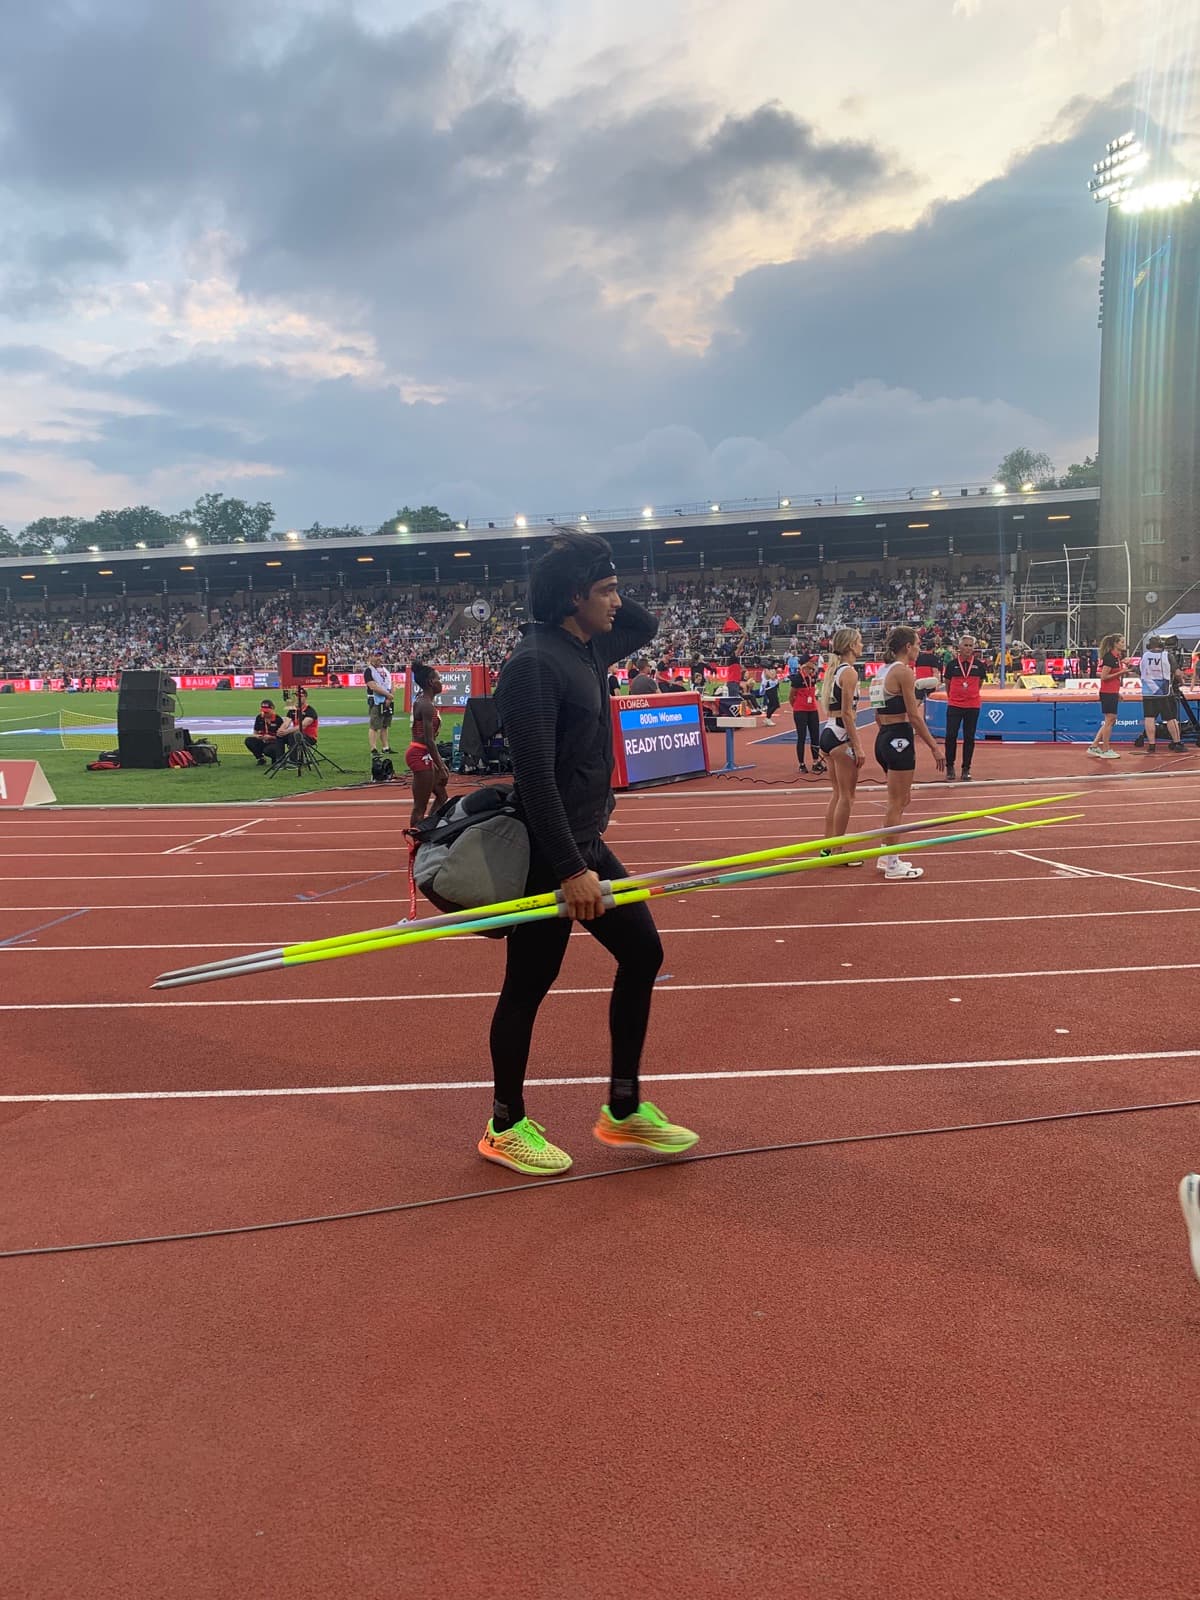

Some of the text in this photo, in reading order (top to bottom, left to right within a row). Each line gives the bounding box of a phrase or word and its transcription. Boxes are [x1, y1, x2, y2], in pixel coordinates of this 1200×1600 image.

[313, 655, 326, 676] 2
[1147, 657, 1161, 666] TV
[626, 699, 650, 710] OMEGA
[639, 711, 683, 725] 800m Women
[1101, 719, 1138, 727] nicsport
[625, 731, 700, 755] READY TO START
